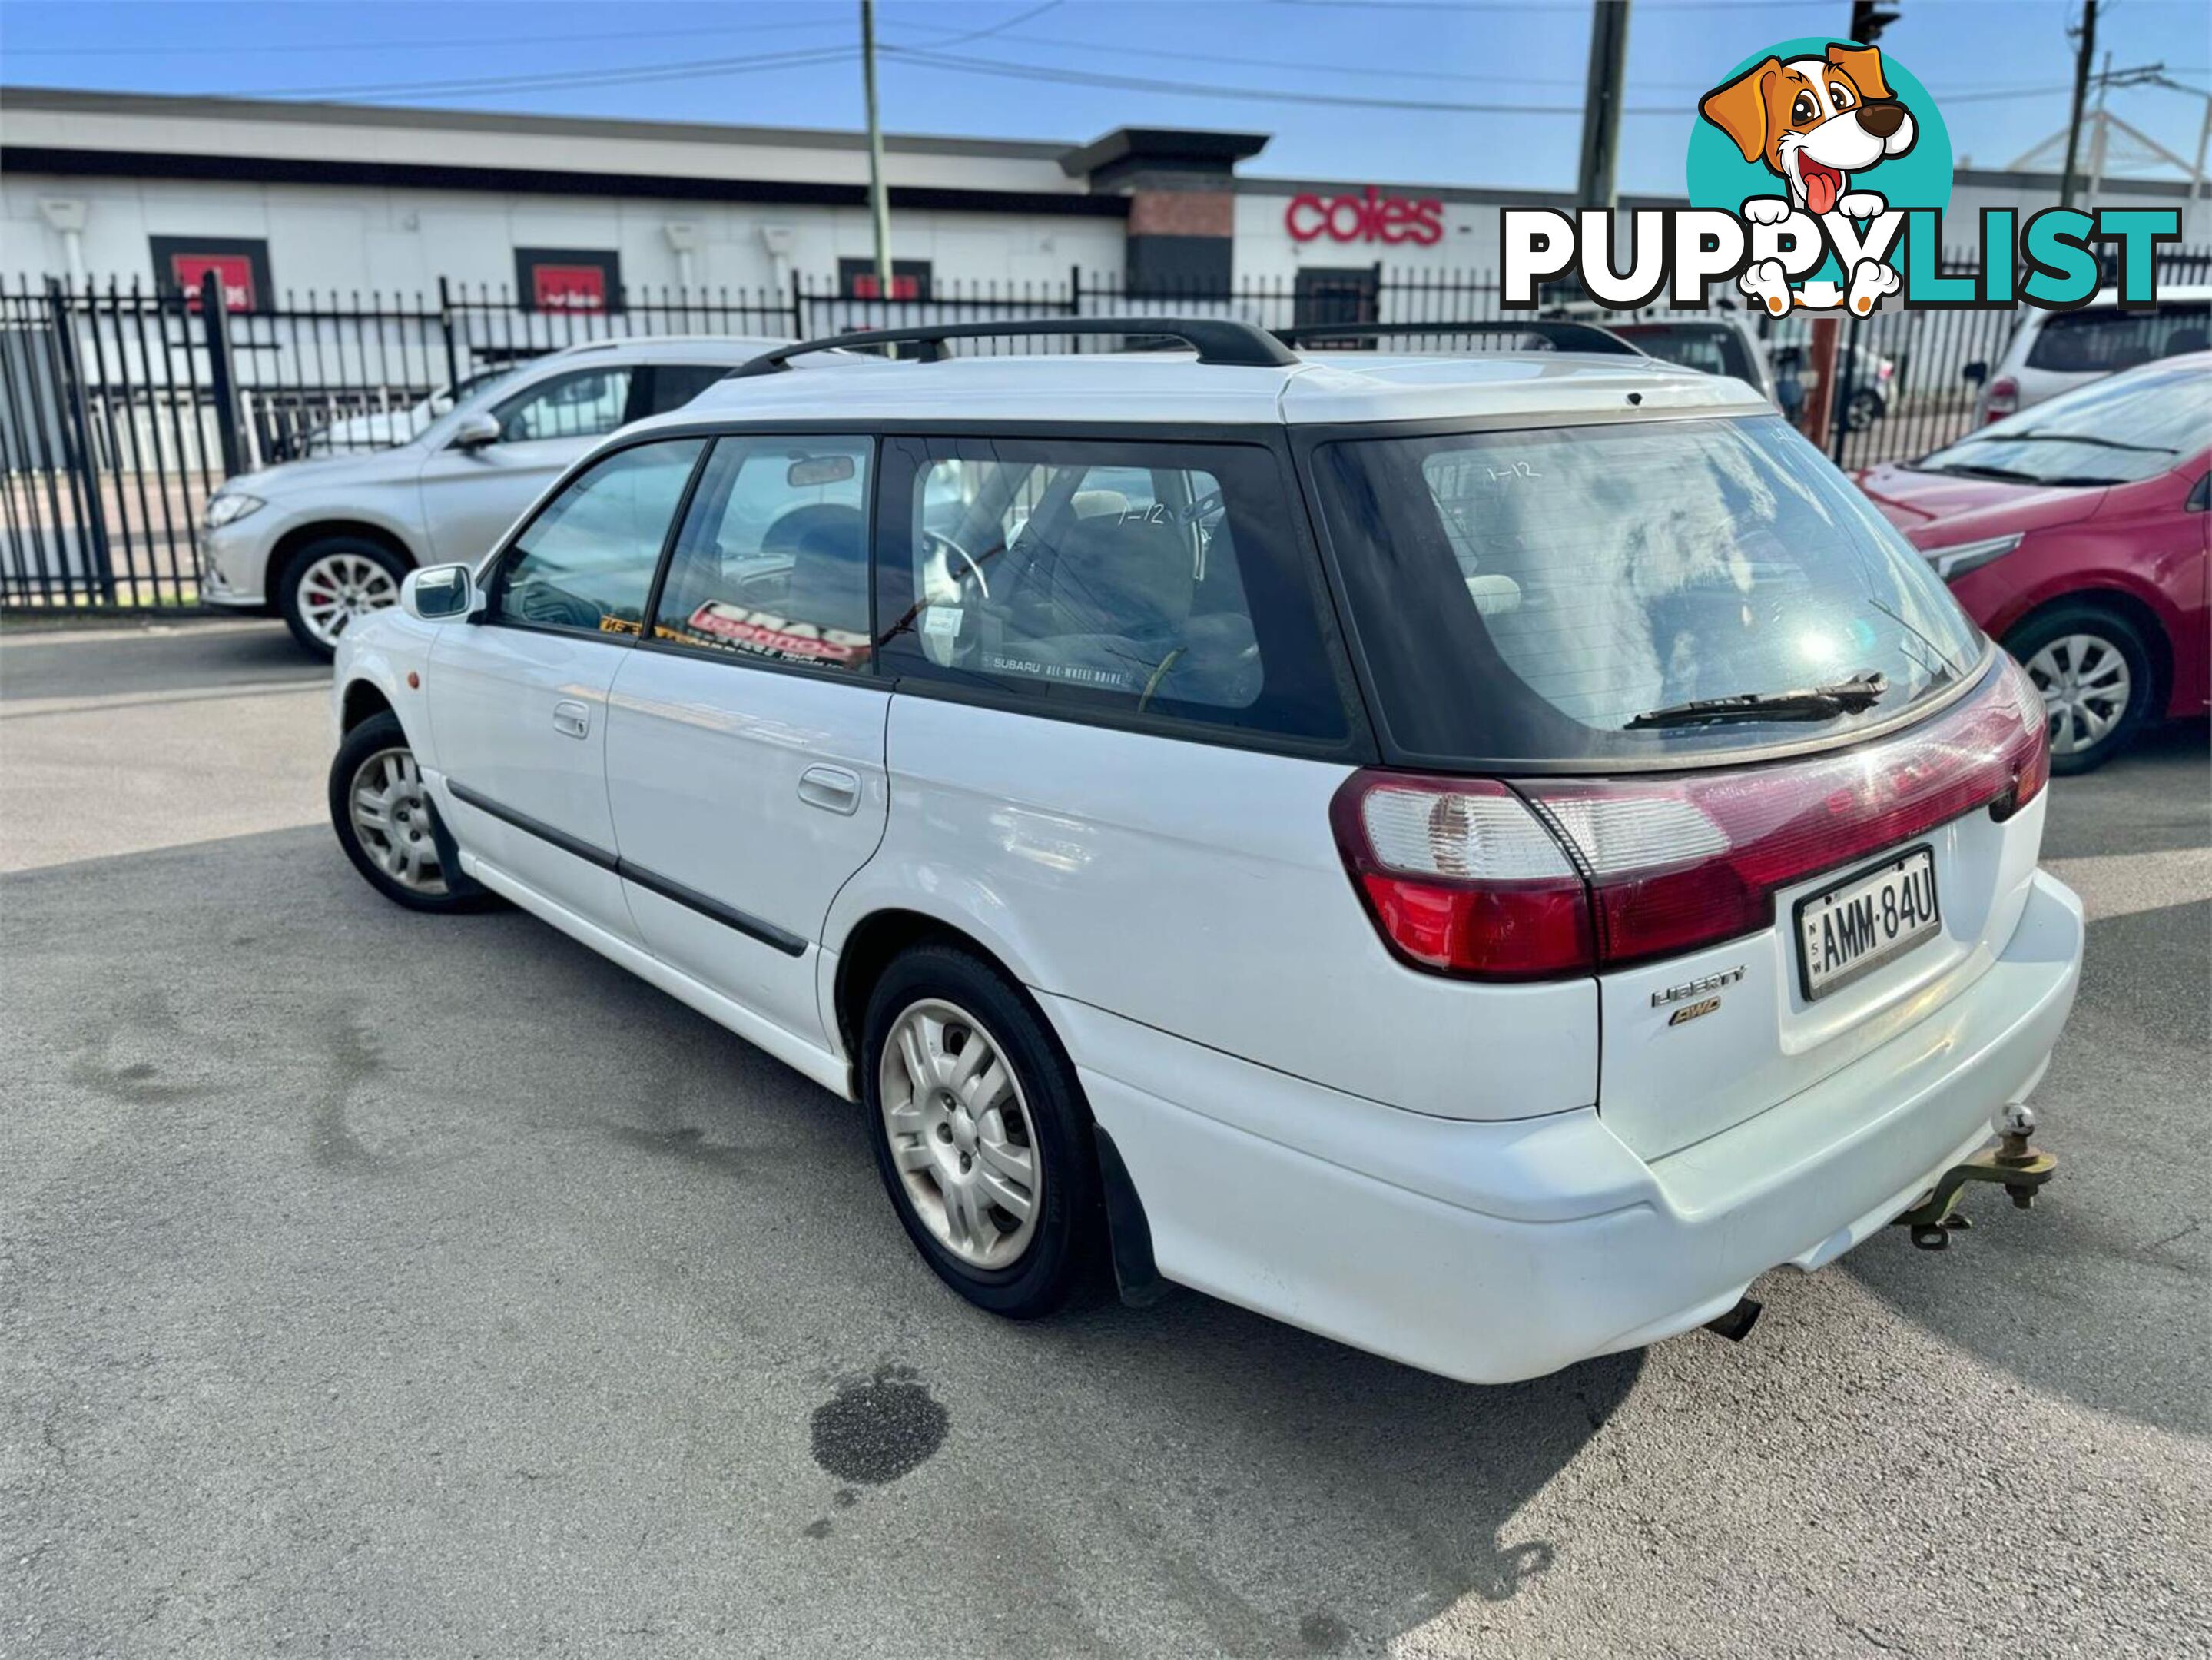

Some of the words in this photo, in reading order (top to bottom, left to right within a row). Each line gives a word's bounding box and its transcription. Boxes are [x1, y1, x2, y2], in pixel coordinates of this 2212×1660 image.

[1285, 184, 1443, 247] coles
[1487, 462, 1543, 481] 1-12
[1117, 503, 1166, 526] 1-12
[994, 658, 1040, 674] SUBARU
[1651, 964, 1750, 1008] LIBERTY
[1668, 995, 1722, 1026] AWD
